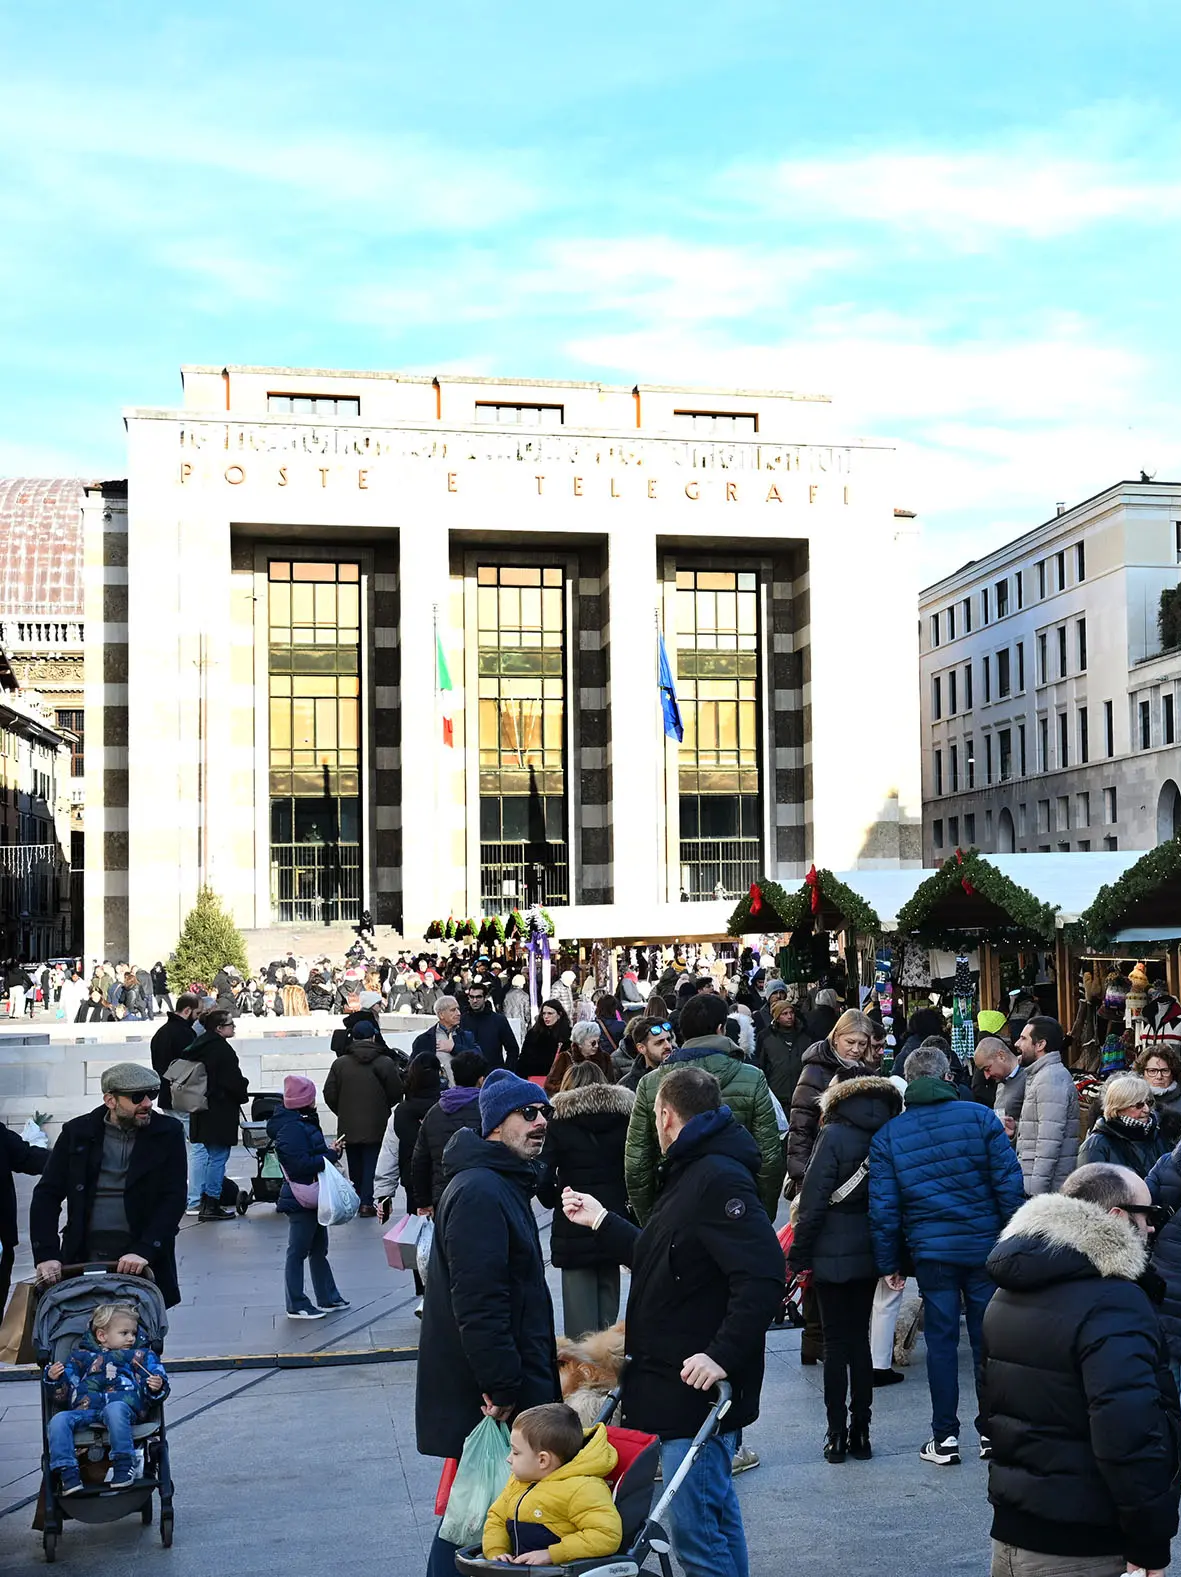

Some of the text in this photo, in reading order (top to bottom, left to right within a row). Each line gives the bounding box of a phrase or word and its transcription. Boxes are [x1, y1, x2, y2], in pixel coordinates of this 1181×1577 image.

[179, 462, 850, 506] POSTE E TELEGRAFI
